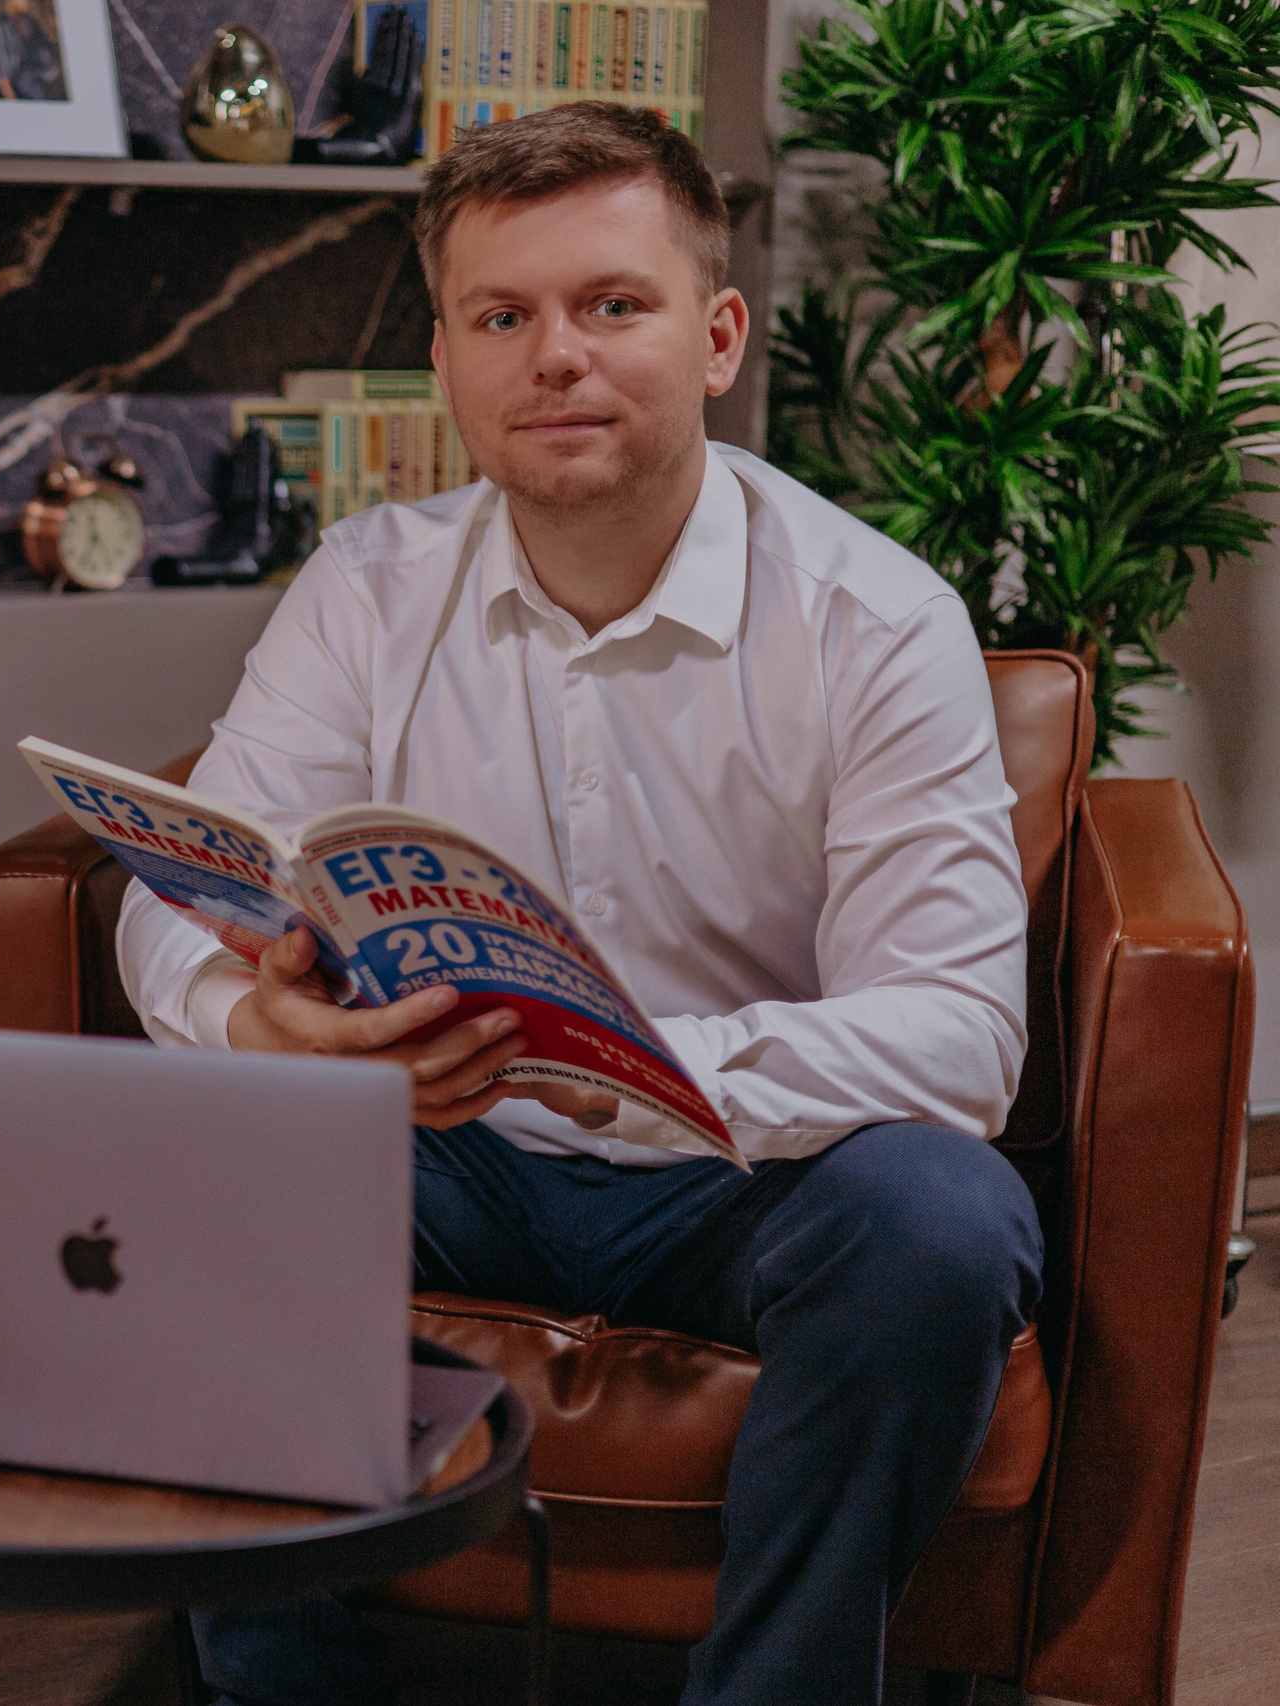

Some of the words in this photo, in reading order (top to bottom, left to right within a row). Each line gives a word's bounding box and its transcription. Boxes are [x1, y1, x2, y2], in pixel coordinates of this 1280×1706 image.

[53, 775, 154, 829] ЕГЭ
[187, 818, 282, 871] 202
[96, 816, 294, 896] МАТЕМАТИ
[324, 845, 446, 897] ЕГЭ
[368, 885, 598, 970] МАТЕМАТИ
[386, 923, 477, 976] 20
[564, 1026, 604, 1049] ПОД
[594, 1079, 661, 1112] ИТОГОВАЯ
